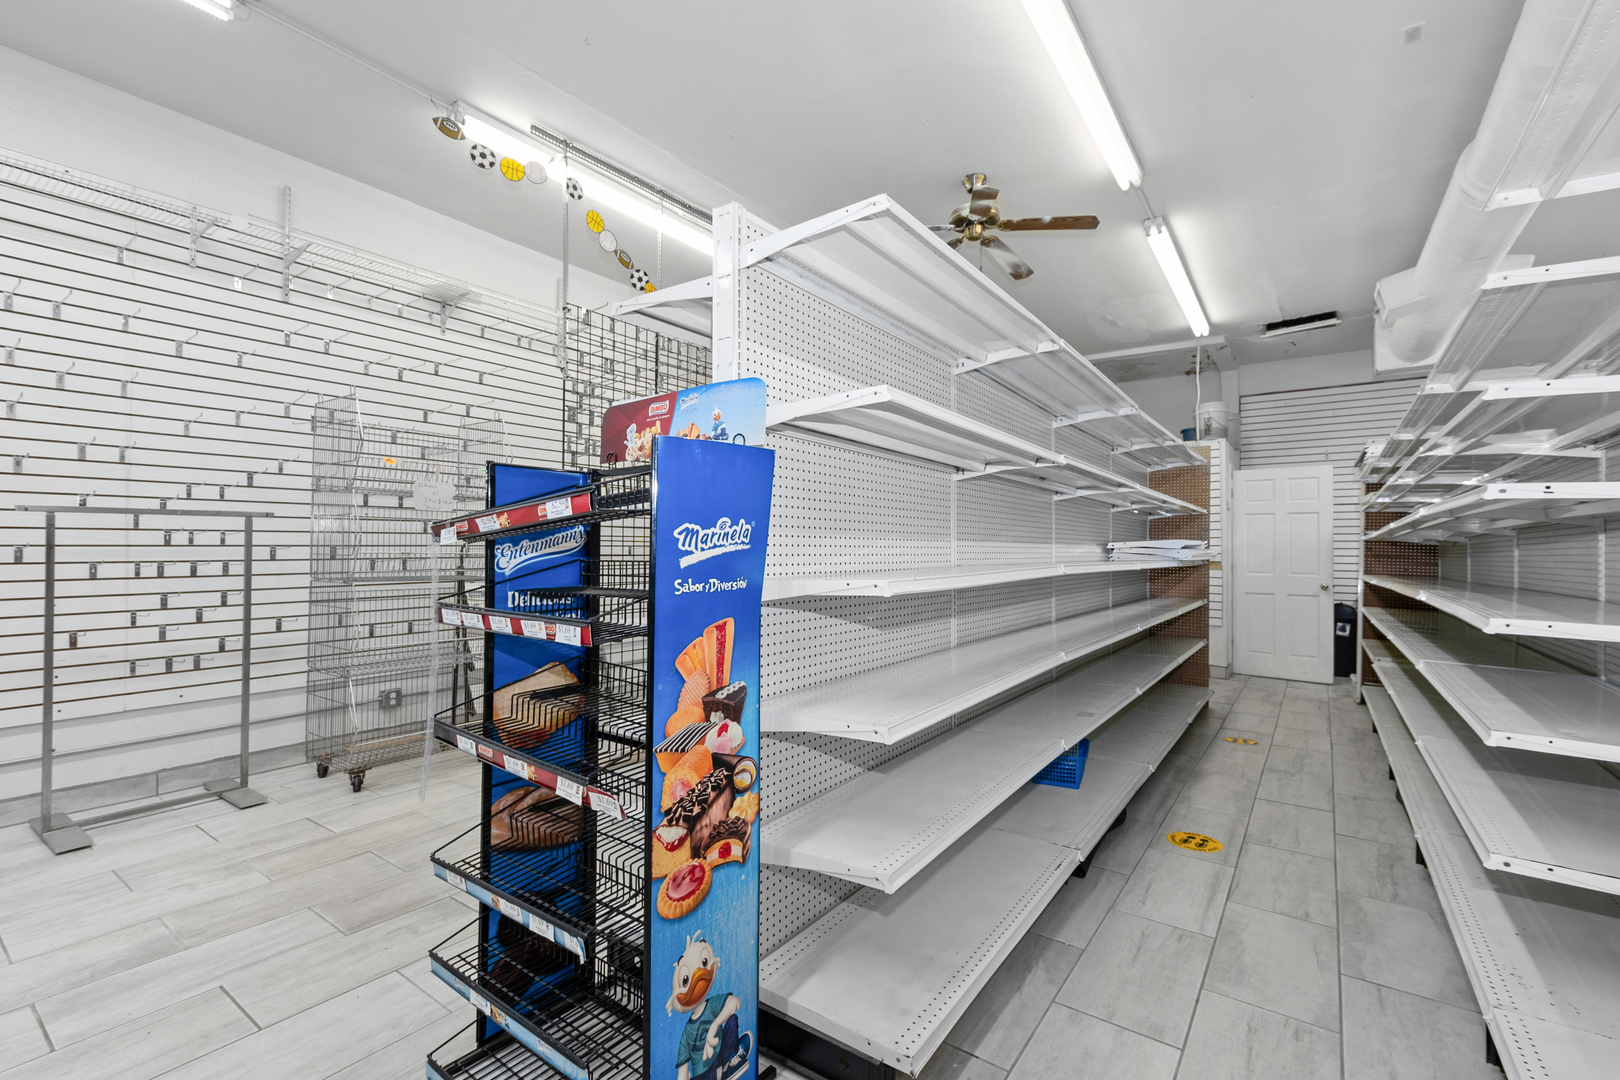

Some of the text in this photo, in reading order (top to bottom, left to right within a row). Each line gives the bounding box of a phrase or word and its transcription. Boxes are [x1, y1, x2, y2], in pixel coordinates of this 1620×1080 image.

[674, 517, 752, 554] Marinela
[495, 525, 588, 574] Entenmann's
[673, 576, 748, 595] Sabor y Diversión
[557, 624, 571, 635] $1.69
[559, 777, 574, 791] $1.69
[597, 795, 613, 807] $1.69
[531, 914, 545, 927] $1.69
